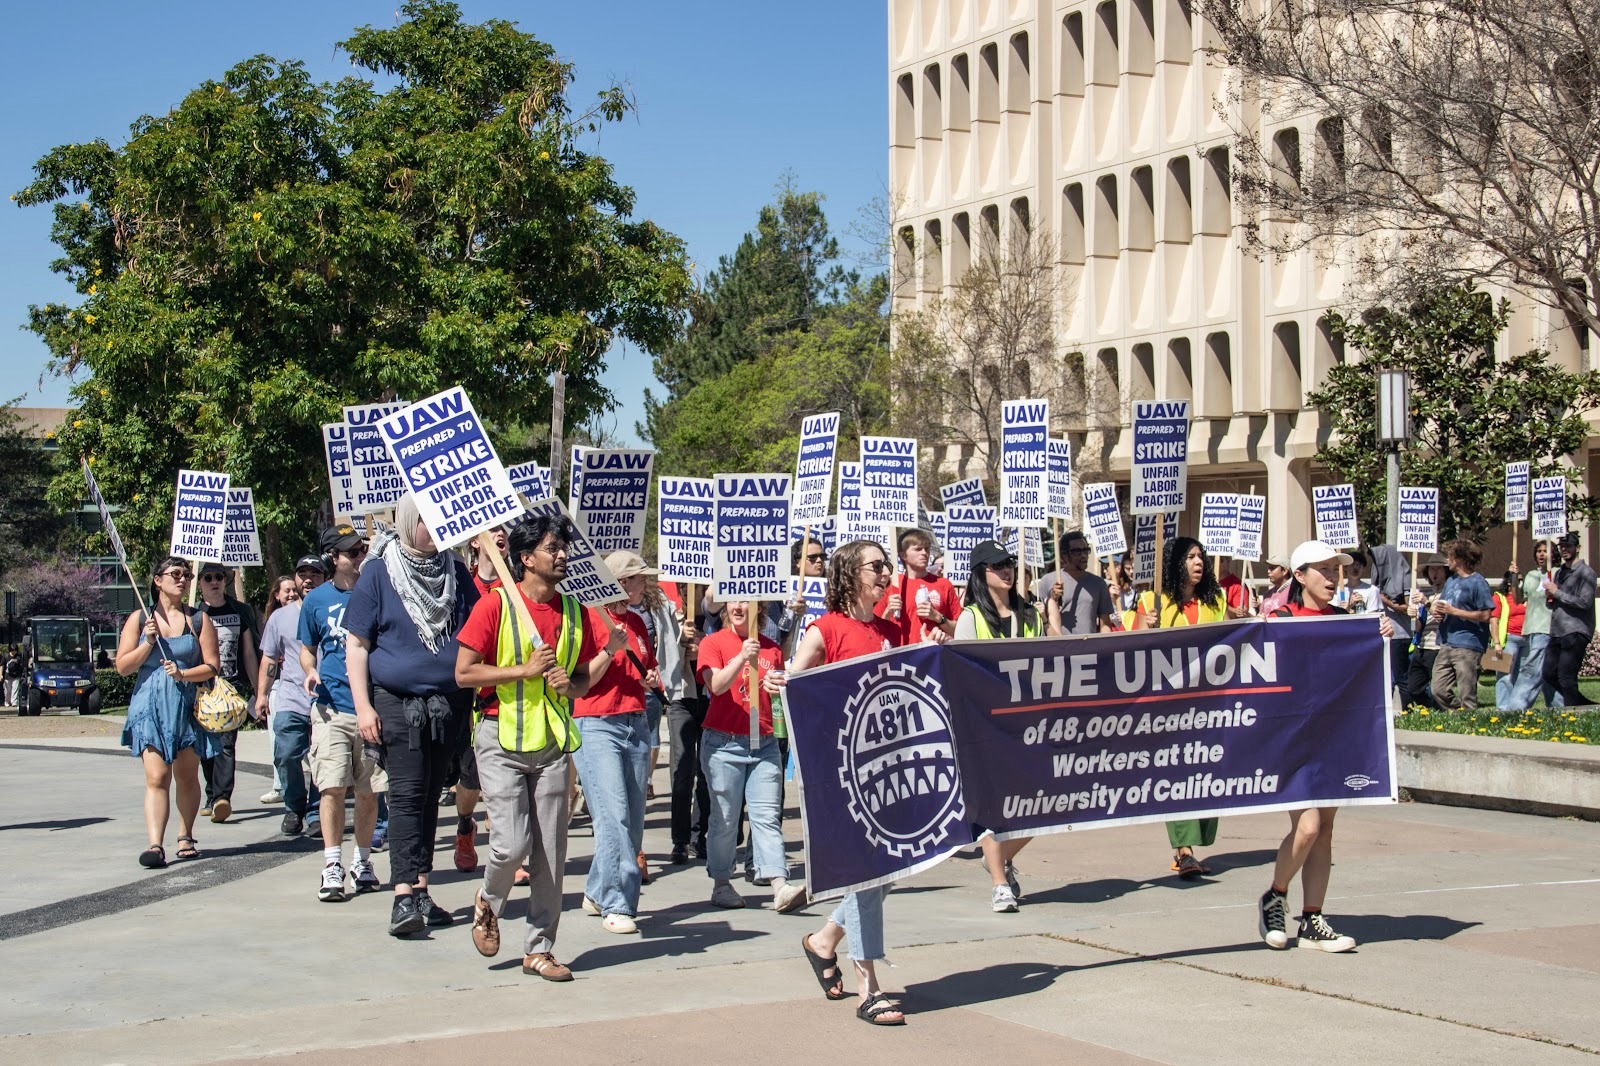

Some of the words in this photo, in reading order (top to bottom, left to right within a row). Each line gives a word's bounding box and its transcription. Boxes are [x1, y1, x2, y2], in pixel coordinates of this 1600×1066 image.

[383, 392, 463, 440] UAW
[1004, 404, 1046, 424] UAW
[1137, 403, 1186, 419] UAW
[804, 416, 837, 436] UAW
[1138, 425, 1174, 434] PREPARED
[1176, 425, 1185, 433] TO
[400, 428, 455, 459] PREPARED
[457, 420, 473, 433] TO
[1005, 433, 1033, 443] PREPARED
[1035, 432, 1044, 442] TO
[802, 442, 825, 454] PREPARED
[826, 441, 833, 450] TO
[864, 440, 913, 454] UAW
[1049, 442, 1068, 455] AW
[1136, 441, 1185, 460] STRIKE
[410, 438, 489, 486] STRIKE
[586, 454, 651, 469] UAW
[799, 456, 831, 475] STRIKE
[865, 459, 901, 467] PREPARED
[1004, 450, 1045, 468] STRIKE
[510, 464, 534, 480] AW
[1143, 466, 1179, 479] UNFAIR
[1508, 464, 1527, 474] UAW
[182, 474, 227, 489] UAW
[586, 478, 630, 486] PREPARED
[634, 478, 645, 486] TO
[865, 472, 913, 486] STRIKE
[1009, 475, 1040, 488] UNFAIR
[1049, 470, 1069, 483] RIKE
[429, 467, 491, 504] UNFAIR
[718, 479, 788, 497] UAW
[800, 479, 825, 492] UNFAIR
[943, 479, 979, 498] UAW
[1048, 485, 1066, 495] NFAIR
[1144, 480, 1176, 493] LABOR
[1507, 485, 1526, 495] STRIKE
[1534, 479, 1562, 490] UAW
[180, 493, 212, 502] PREPARED
[800, 493, 822, 505] LABOR
[871, 489, 908, 500] UNFAIR
[1010, 491, 1038, 504] LABOR
[1084, 486, 1112, 501] UAW
[1315, 487, 1350, 498] UAW
[1401, 490, 1436, 499] UAW
[440, 485, 497, 519] LABOR
[582, 492, 644, 507] STRIKE
[873, 501, 906, 510] LABOR
[1048, 495, 1065, 504] ABOR
[1136, 493, 1183, 508] PRACTICE
[1205, 496, 1237, 504] UAW
[1242, 498, 1263, 508] UAW
[1534, 500, 1563, 511] STRIKE
[179, 506, 222, 522] STRIKE
[664, 504, 704, 514] PREPARED
[720, 507, 769, 517] PREPARED
[772, 508, 785, 518] TO
[793, 506, 826, 519] PRACTICE
[949, 508, 994, 520] UAW
[1003, 506, 1045, 520] PRACTICE
[1048, 505, 1070, 515] ACTICE
[1317, 509, 1353, 521] STRIKE
[436, 495, 517, 541] PRACTICE
[588, 512, 635, 524] UNFAIR
[865, 511, 914, 522] PRACTICE
[1090, 511, 1118, 527] STRIKE
[1203, 517, 1236, 527] STRIKE
[1401, 513, 1434, 523] STRIKE
[1538, 512, 1559, 520] UNFAIR
[182, 524, 215, 535] UNFAIR
[225, 519, 254, 530] RIKE
[1095, 525, 1117, 536] UNFAIR
[1239, 520, 1260, 532] STRIKE
[1323, 522, 1349, 530] UNFAIR
[1539, 520, 1558, 528] LABOR
[588, 526, 630, 537] LABOR
[719, 525, 786, 543] STRIKE
[1325, 530, 1349, 538] LABOR
[1535, 527, 1563, 535] PRACTICE
[183, 535, 212, 545] LABOR
[589, 539, 639, 549] ACTICE
[669, 539, 710, 552] UNFAIR
[1098, 534, 1118, 544] LABOR
[1240, 541, 1255, 549] LABOR
[174, 545, 219, 557] PRACTICE
[222, 544, 250, 552] ABOR
[1096, 541, 1125, 553] PRACTICE
[1237, 549, 1258, 558] PRACTICE
[221, 553, 259, 562] RACTICE
[671, 552, 708, 565] LABOR
[727, 549, 778, 562] UNFAIR
[566, 561, 596, 578] FAIR
[662, 564, 714, 580] PRACTIC
[730, 565, 776, 578] LABOR
[560, 574, 602, 592] LABOR
[719, 580, 787, 595] PRACTICE
[793, 580, 828, 594] UA
[568, 584, 621, 603] ACTICE
[999, 654, 1098, 702] THE
[1114, 642, 1277, 693] UNION
[879, 692, 900, 707] UAW
[865, 700, 925, 744] 4811
[1023, 718, 1047, 745] of
[1049, 714, 1133, 743] 48,000
[1134, 701, 1257, 735] Academic
[1053, 749, 1150, 777] Workers
[1154, 744, 1180, 766] at
[1184, 741, 1224, 764] the
[1003, 782, 1124, 819] University
[1126, 778, 1151, 804] of
[1154, 768, 1278, 801] California
